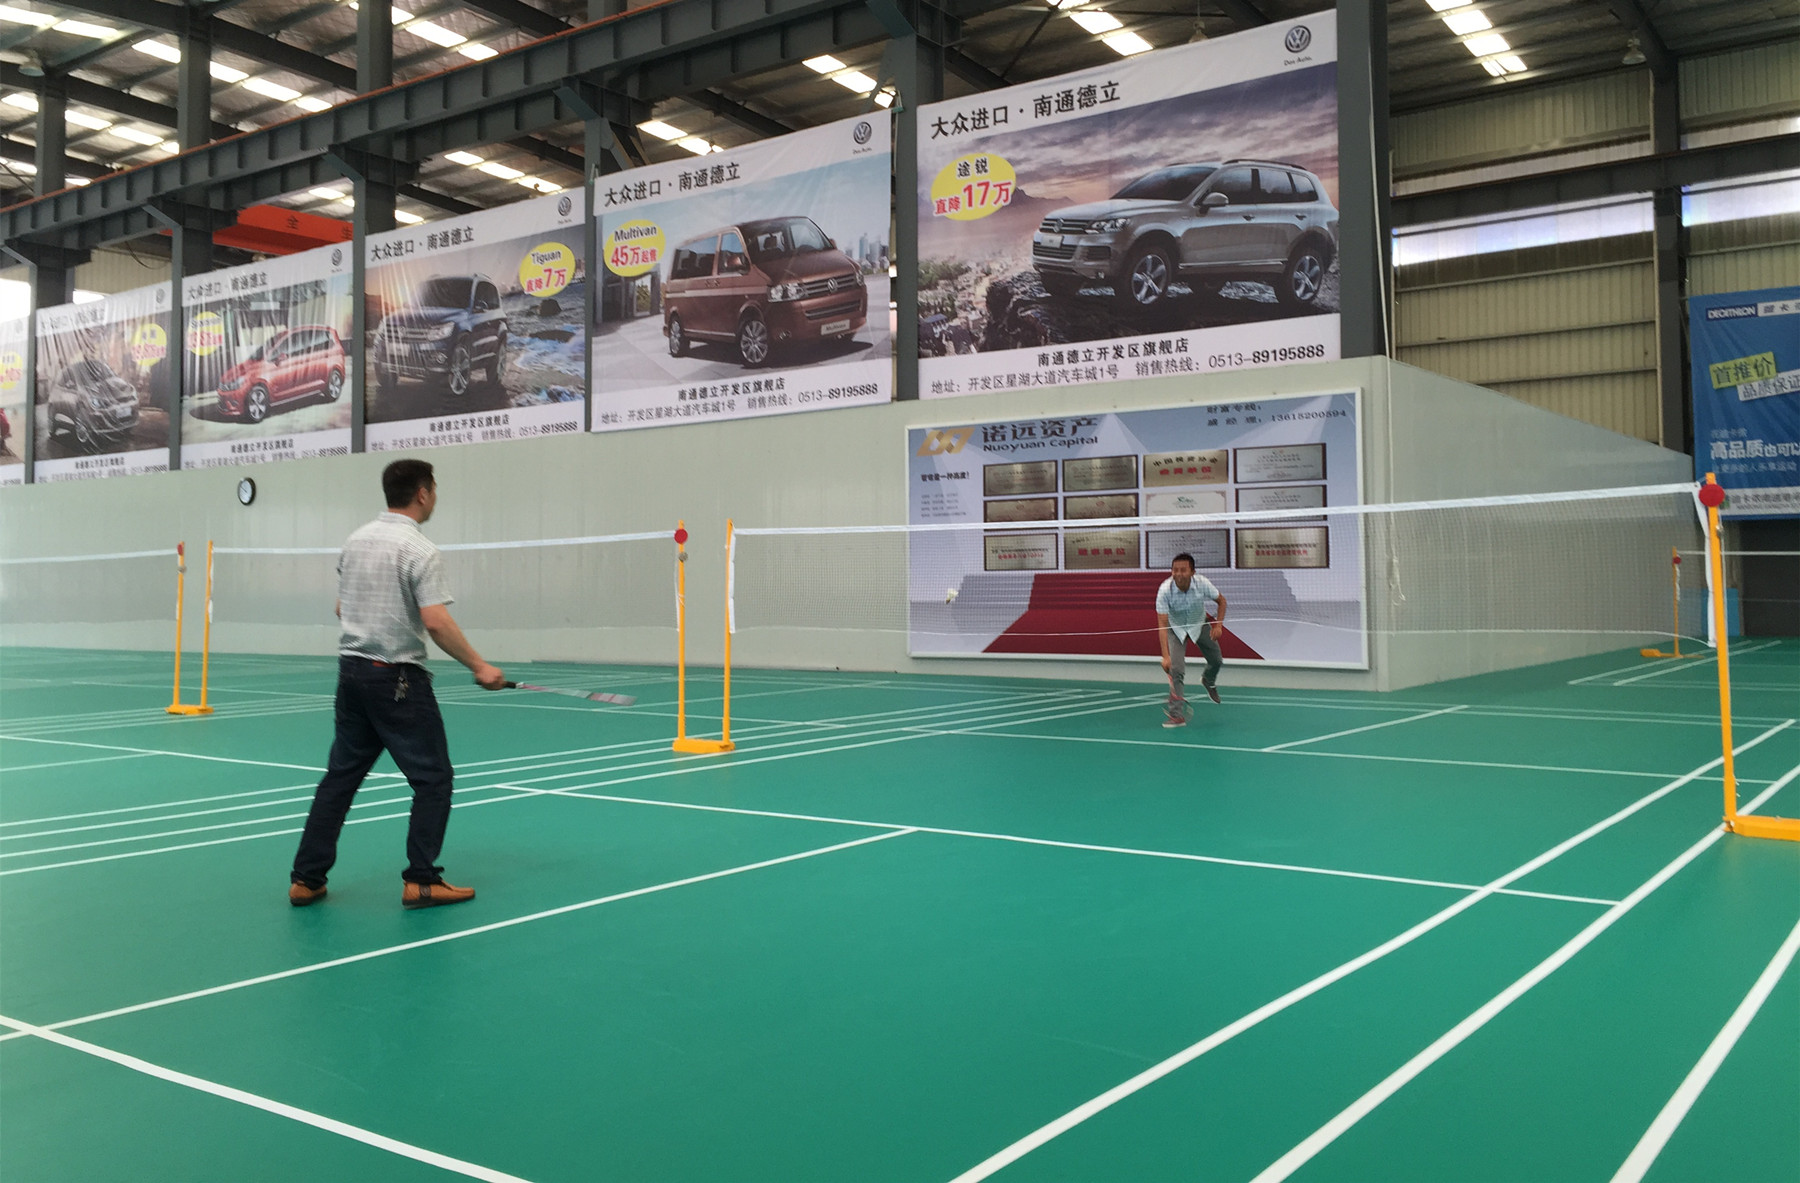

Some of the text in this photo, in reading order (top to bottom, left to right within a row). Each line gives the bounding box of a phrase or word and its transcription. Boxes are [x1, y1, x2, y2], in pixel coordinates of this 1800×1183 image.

[935, 181, 1012, 214] 直降17万
[614, 226, 657, 241] Multivan
[531, 250, 561, 265] Tiguan
[526, 268, 567, 292] 直降7万
[1037, 337, 1190, 367] 南通德立开发区旗舰店
[1713, 356, 1772, 385] 首推价
[677, 376, 786, 402] 南通德立开发区旗舰店
[982, 417, 1098, 444] 诺远资产
[983, 436, 1098, 453] Nuoyuan Capital
